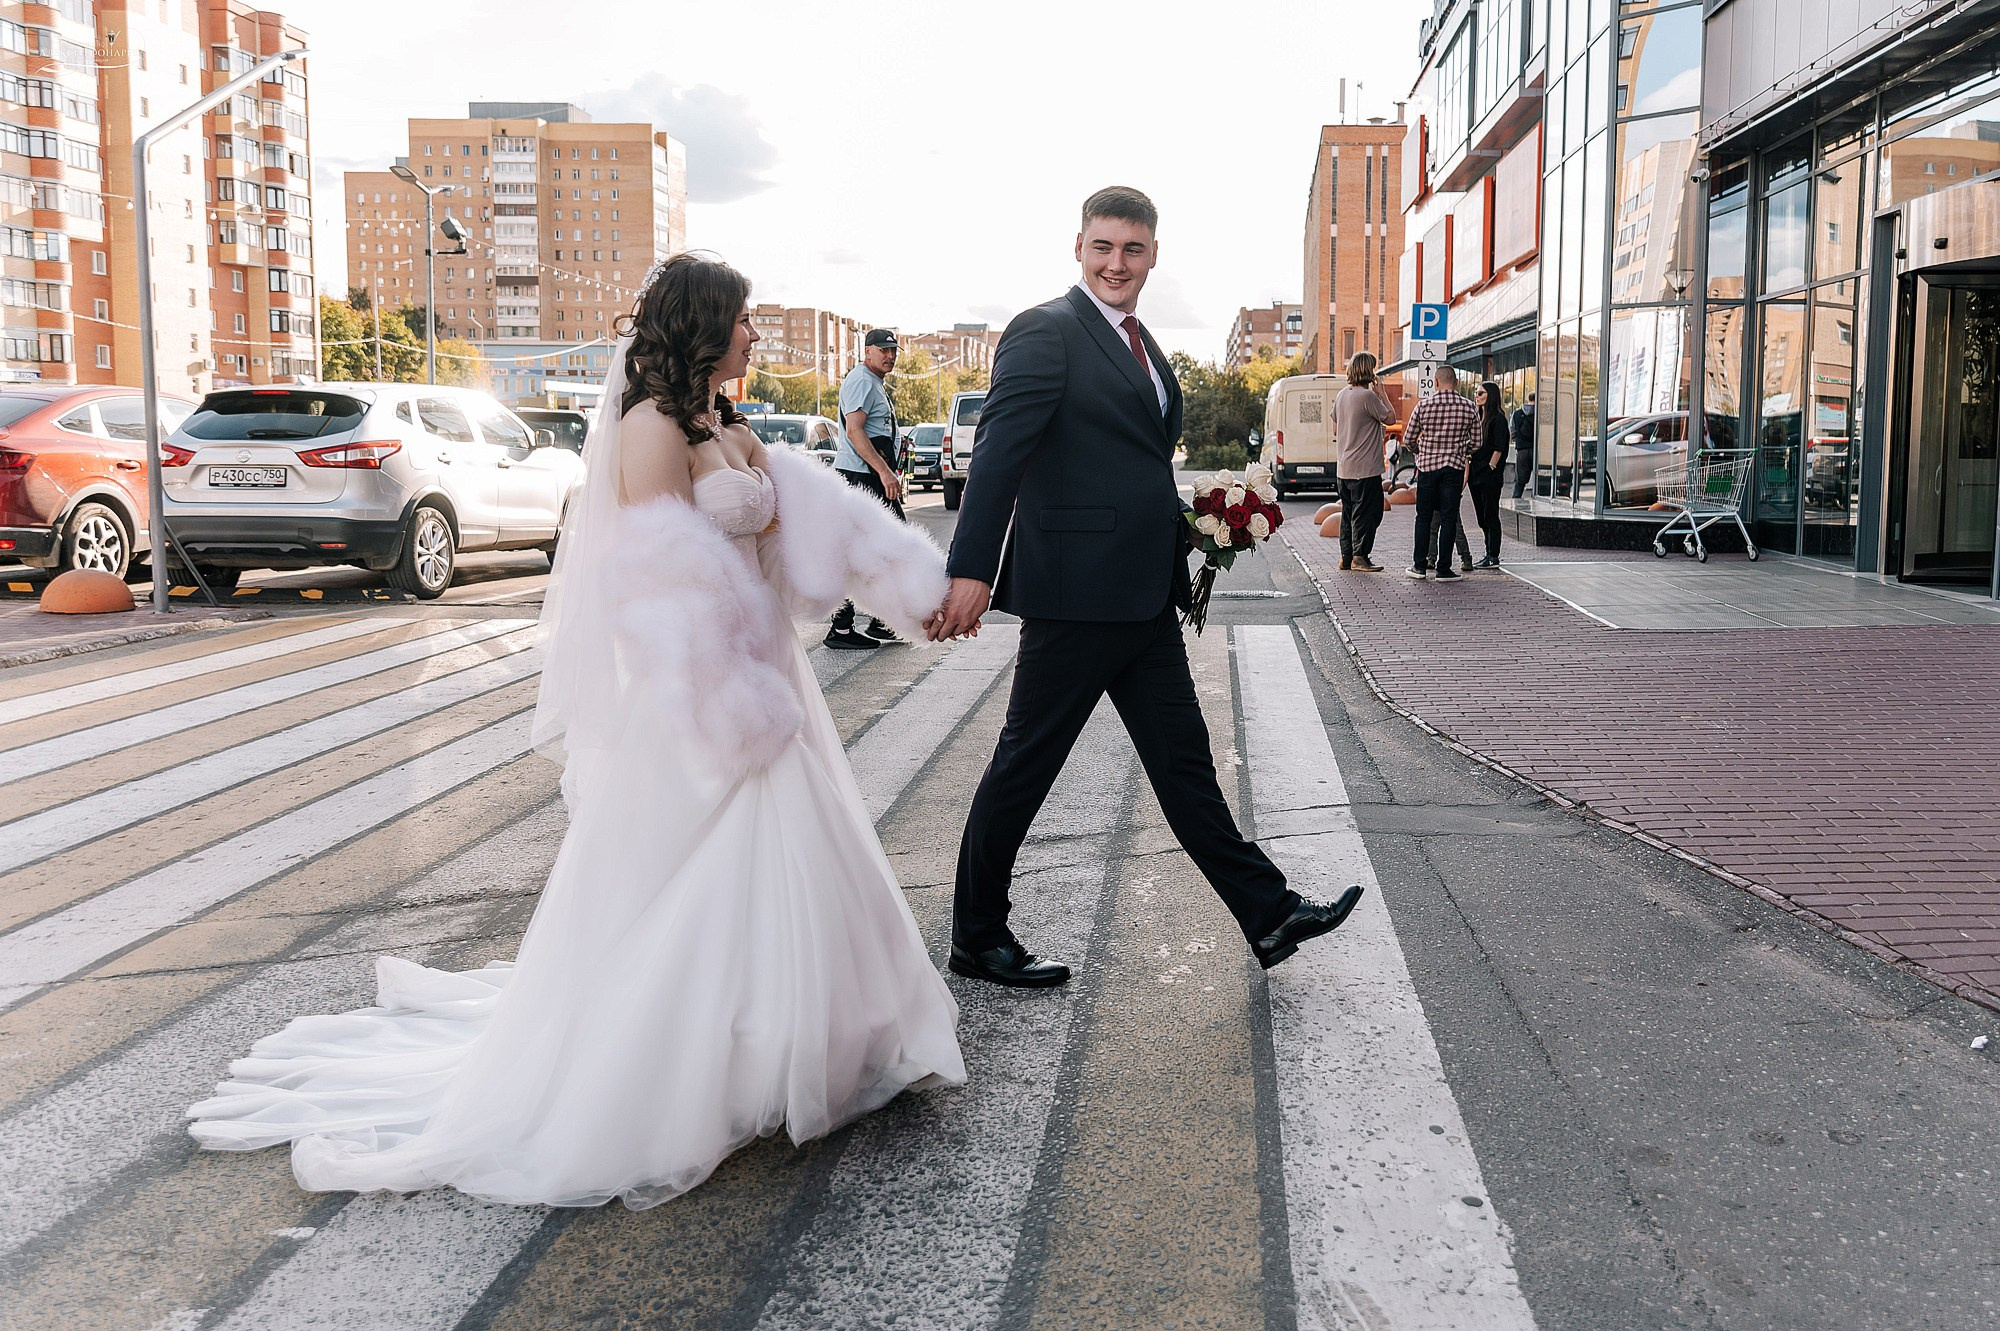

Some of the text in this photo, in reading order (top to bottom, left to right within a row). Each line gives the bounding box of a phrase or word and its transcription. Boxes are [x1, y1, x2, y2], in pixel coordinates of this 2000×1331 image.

[1419, 307, 1440, 337] P
[1420, 379, 1434, 389] 50
[263, 469, 281, 479] 750
